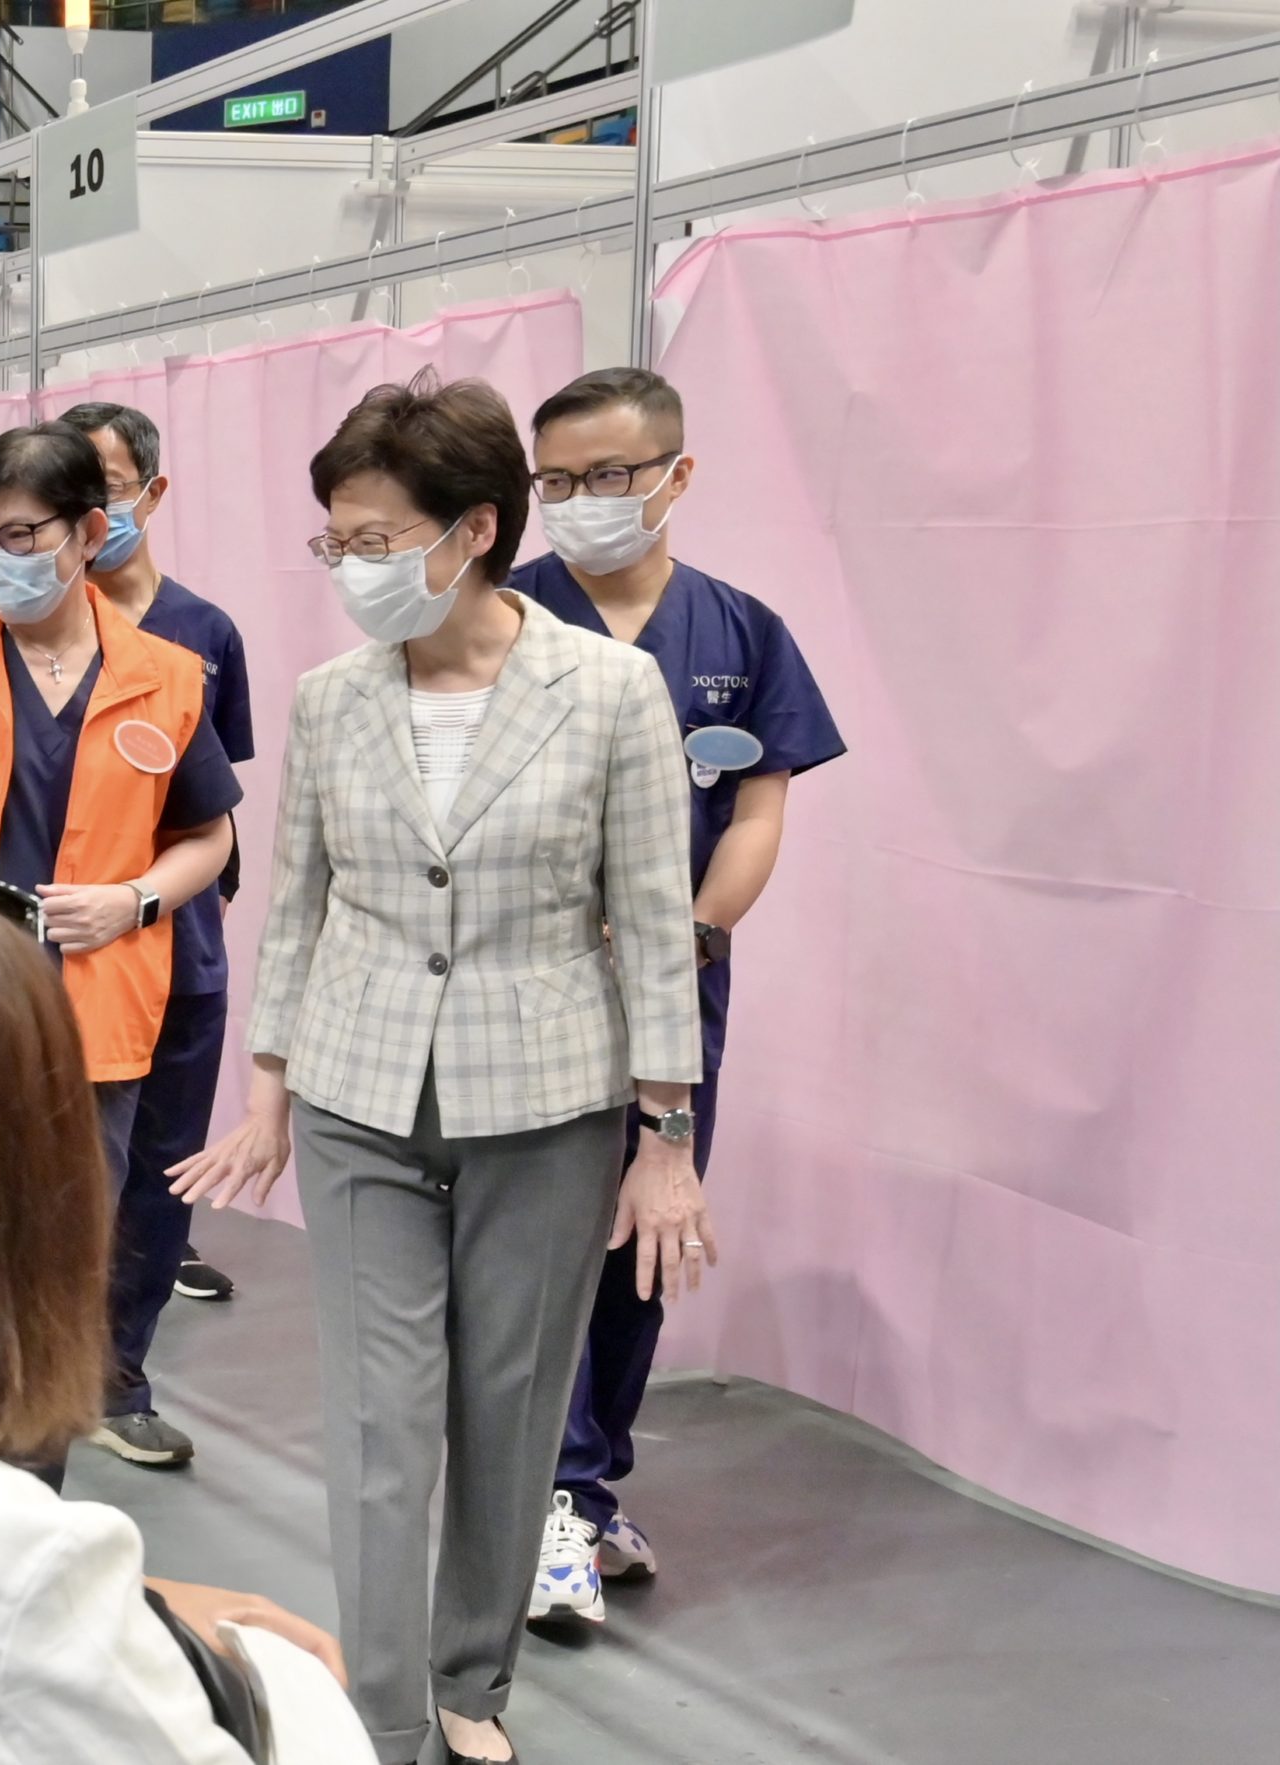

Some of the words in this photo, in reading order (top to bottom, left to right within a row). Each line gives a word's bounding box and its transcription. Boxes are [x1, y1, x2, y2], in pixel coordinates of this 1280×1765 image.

[231, 101, 267, 121] EXIT
[271, 97, 297, 117] 出口
[69, 146, 105, 200] 10
[706, 690, 733, 704] 醫生
